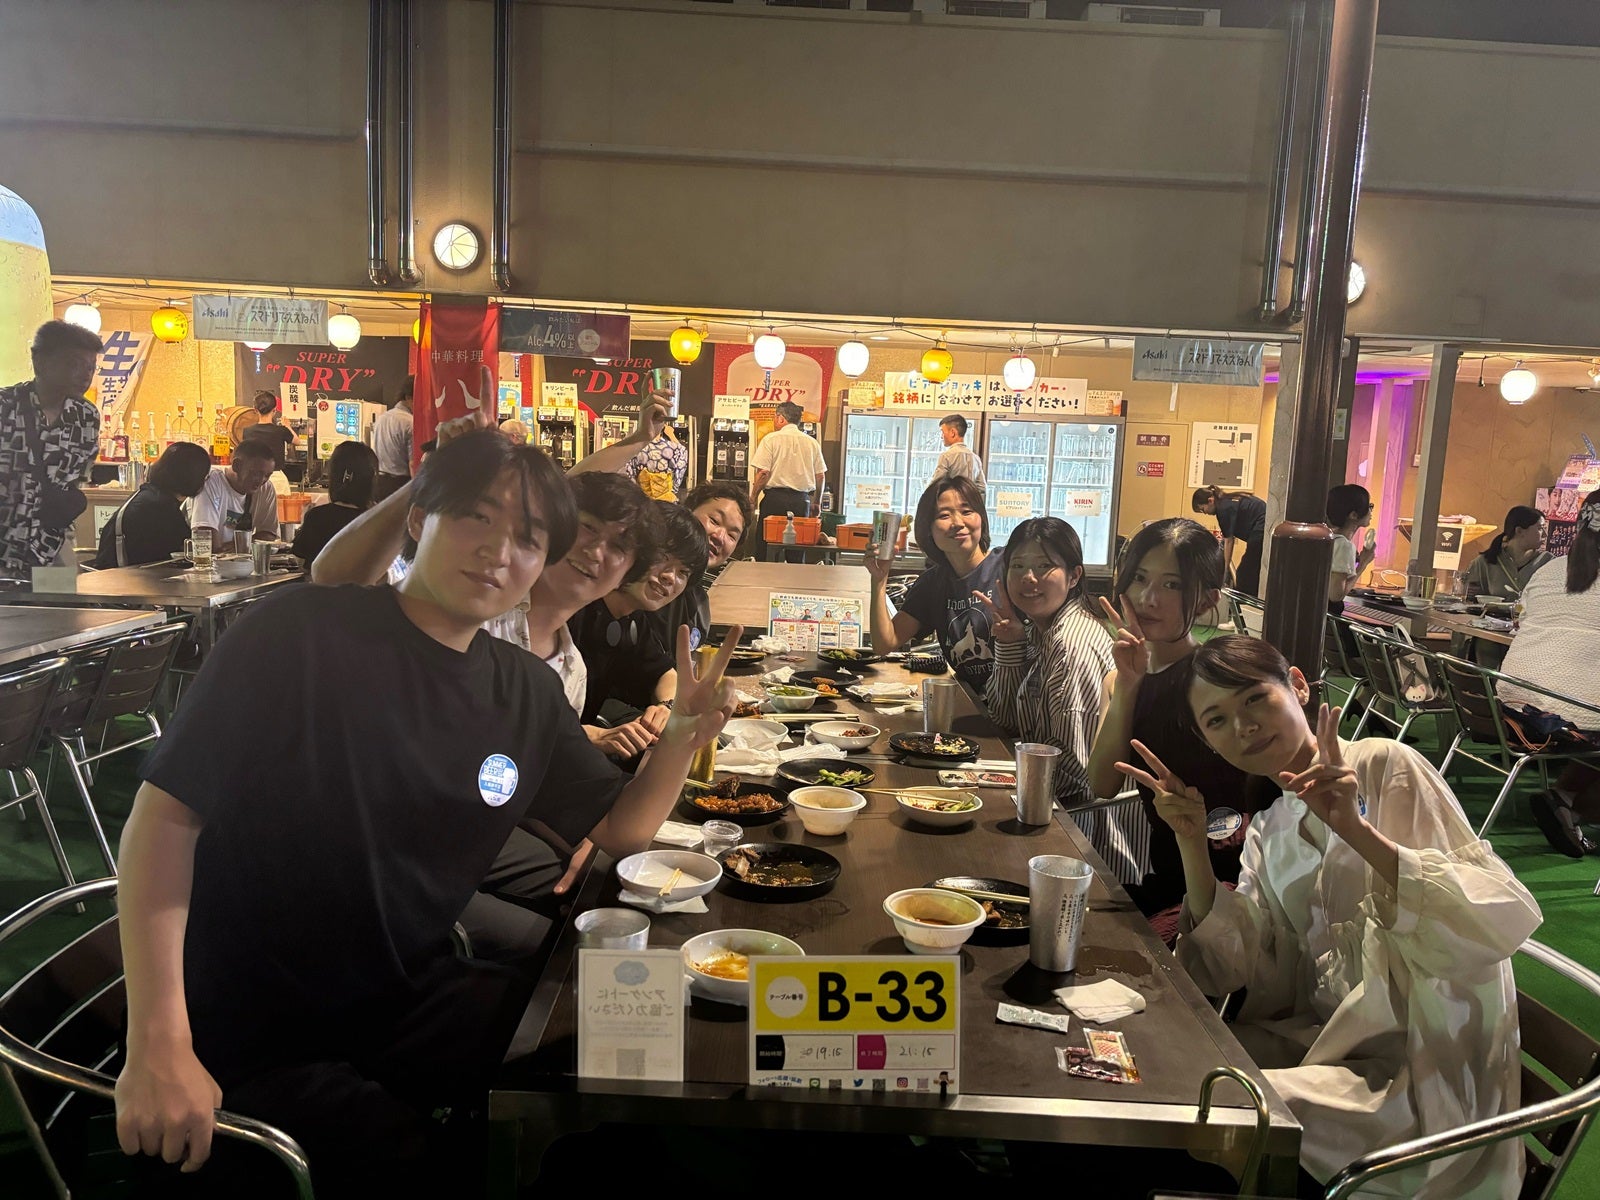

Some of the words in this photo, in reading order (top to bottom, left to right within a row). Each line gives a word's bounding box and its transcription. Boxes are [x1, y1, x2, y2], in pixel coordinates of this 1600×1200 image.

[202, 307, 229, 318] Asahi
[98, 331, 140, 376] 生
[296, 351, 347, 364] SUPER
[431, 350, 484, 364] 中華料理
[1142, 349, 1168, 360] Asahi
[289, 384, 299, 403] 炭酸
[769, 993, 804, 1001] テーブル番号
[818, 970, 948, 1023] B-33
